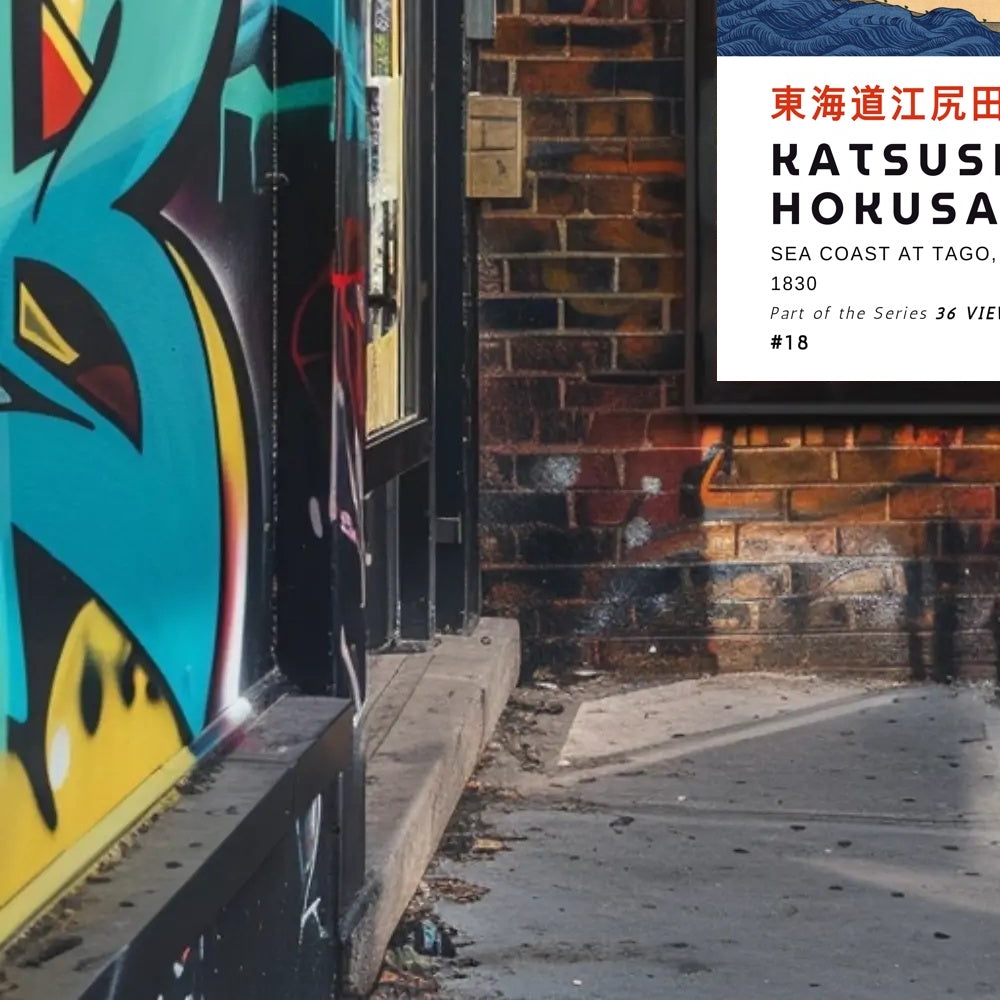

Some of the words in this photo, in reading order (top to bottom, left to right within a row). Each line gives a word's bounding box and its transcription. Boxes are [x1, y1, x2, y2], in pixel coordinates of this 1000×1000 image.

[770, 245, 812, 262] SEA
[819, 245, 891, 262] COAST
[897, 245, 925, 262] AT
[931, 245, 996, 264] TAGO,
[771, 275, 817, 292] 1830
[769, 306, 805, 320] Part
[813, 305, 832, 320] of
[839, 305, 866, 320] the
[873, 305, 928, 320] Series
[935, 306, 957, 321] 36
[770, 334, 809, 351] #18
